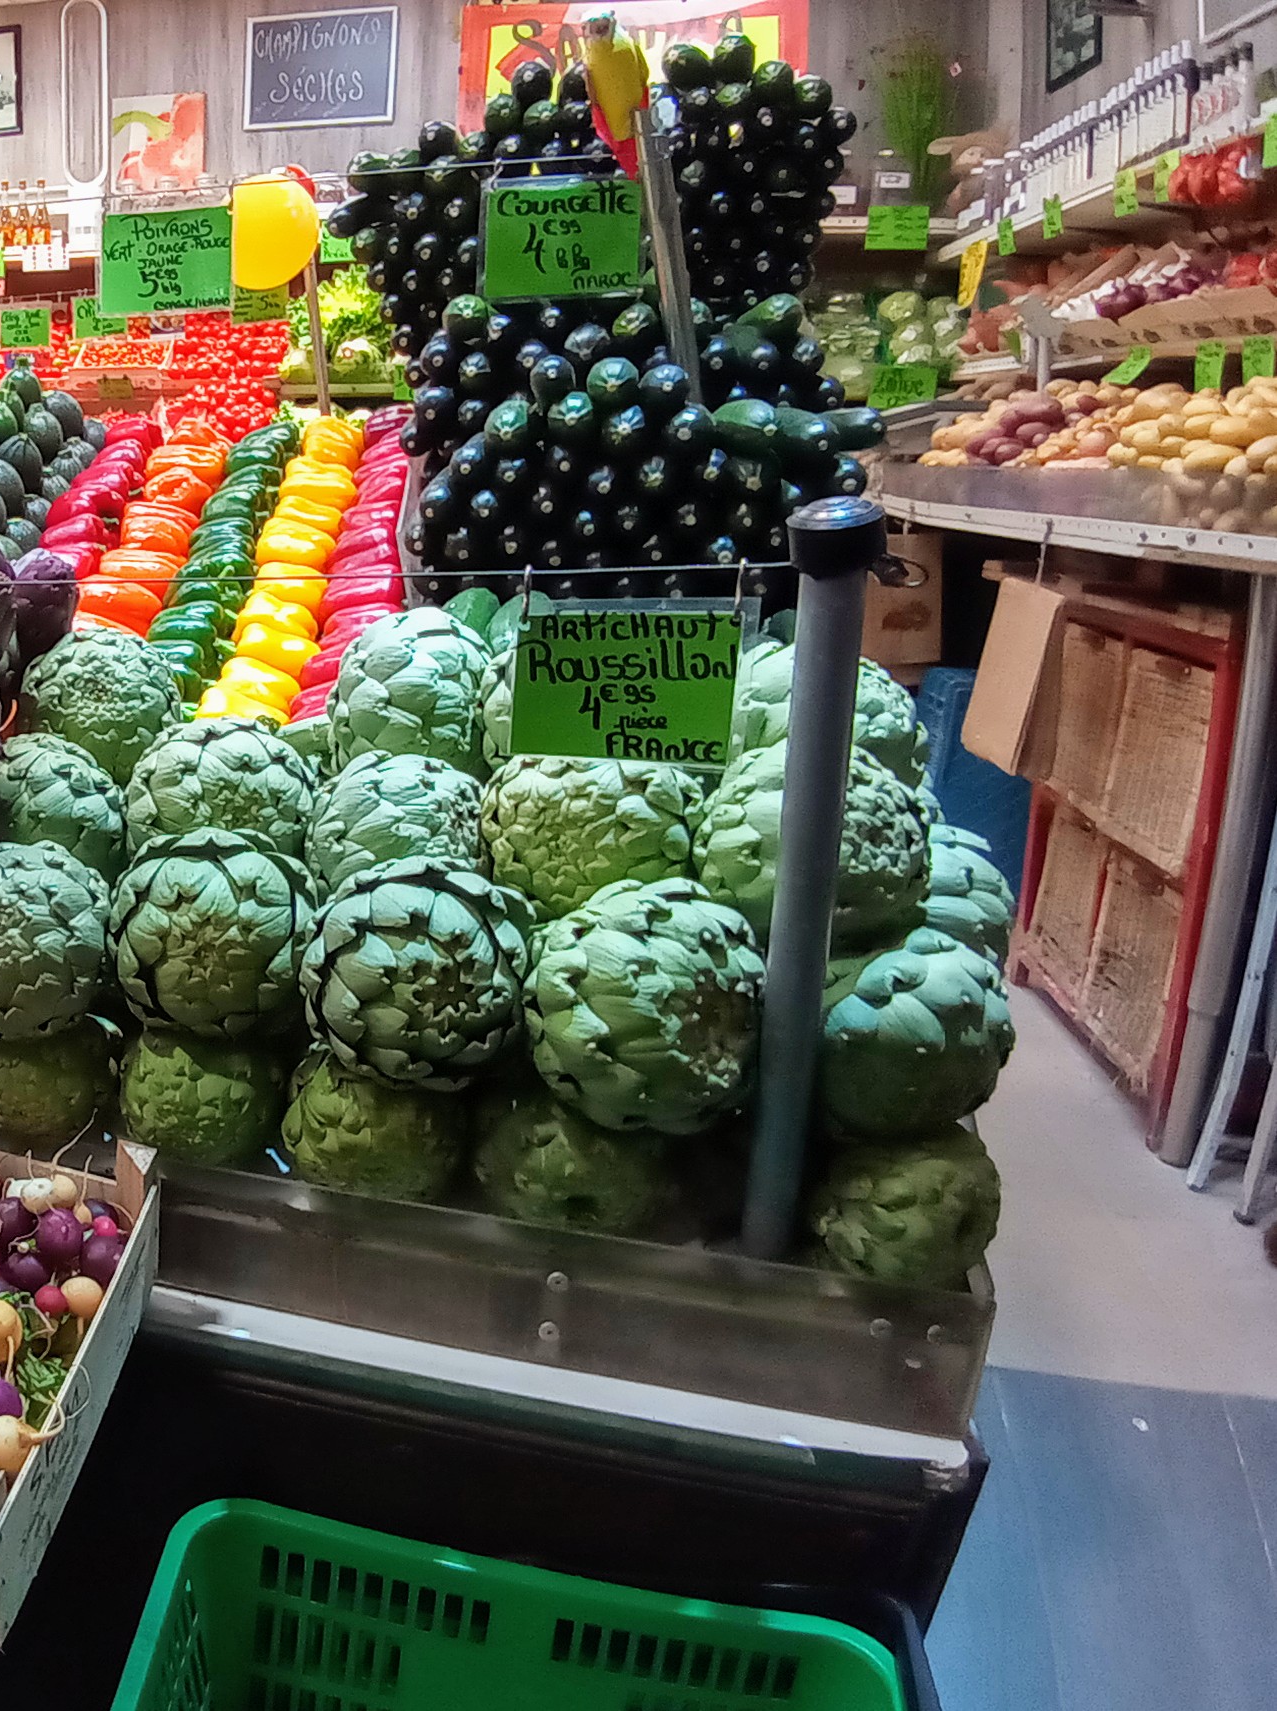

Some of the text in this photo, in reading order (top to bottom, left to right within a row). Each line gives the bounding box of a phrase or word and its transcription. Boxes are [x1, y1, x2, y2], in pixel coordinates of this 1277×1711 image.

[254, 14, 381, 63] CHAMPIGNONS
[496, 181, 637, 217] COURGETTE
[120, 214, 213, 241] POIVRONS
[103, 240, 135, 262] VERT
[137, 254, 184, 270] JAUNE
[573, 271, 639, 290] MAROC
[540, 610, 724, 642] ARTICHAUT
[605, 731, 724, 763] FRANCE
